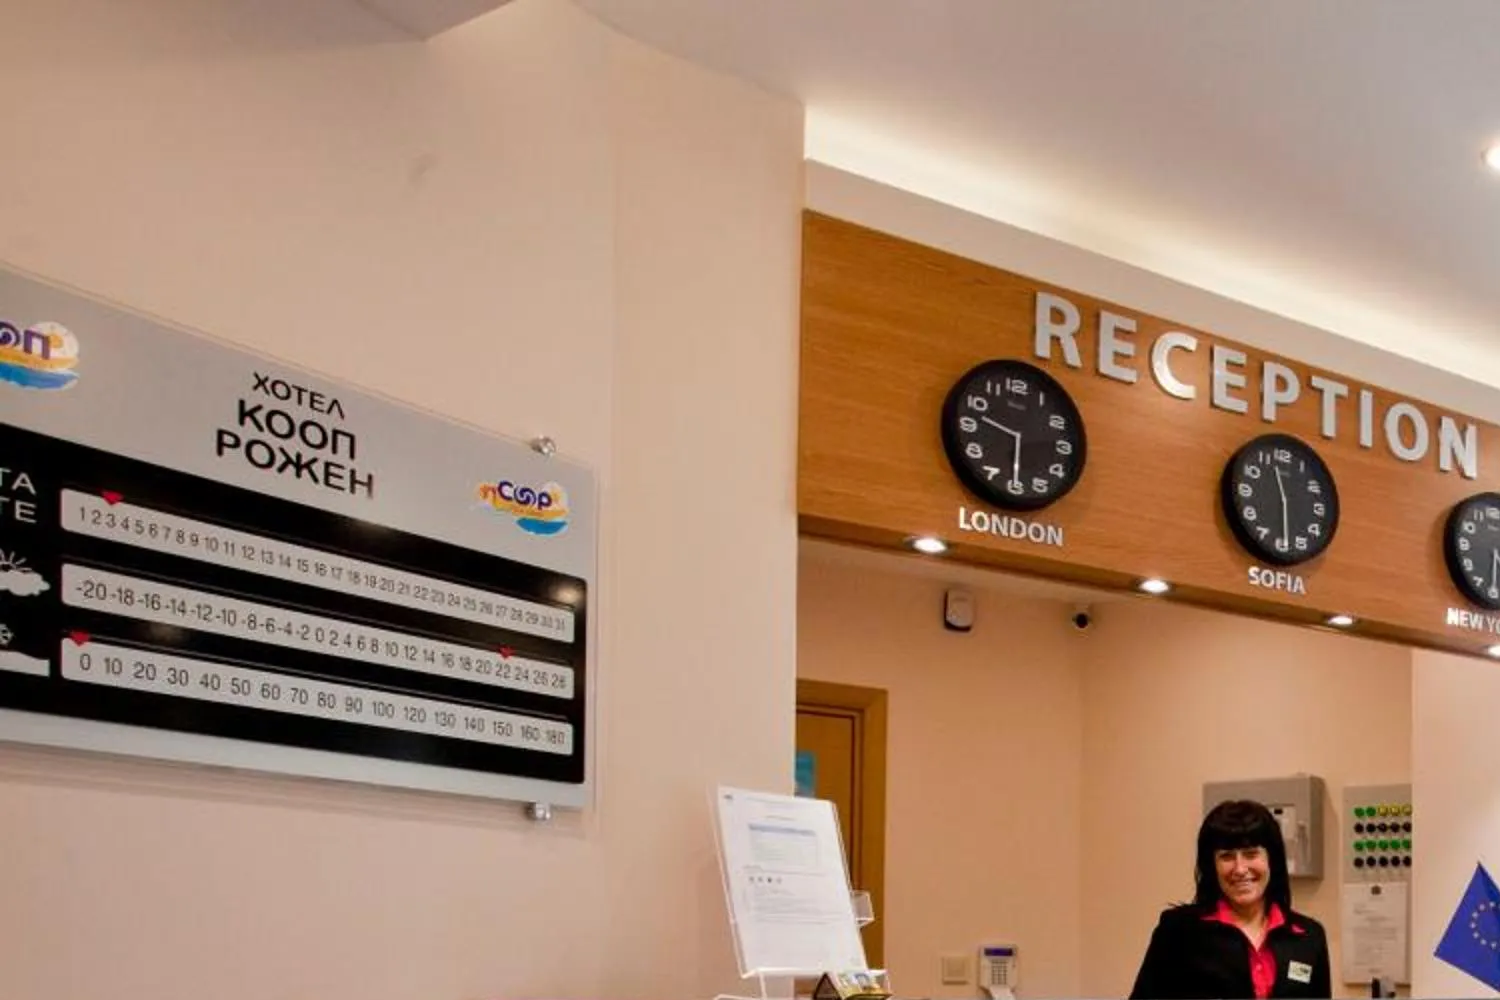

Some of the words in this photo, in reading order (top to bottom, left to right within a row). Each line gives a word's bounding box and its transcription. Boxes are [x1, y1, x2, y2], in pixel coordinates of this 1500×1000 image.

[986, 380, 1001, 396] 11
[1005, 377, 1028, 395] 12
[1034, 291, 1478, 479] RECEPTION
[252, 371, 344, 420] ХОТЕЛ
[967, 395, 988, 411] 10
[1039, 391, 1044, 407] 1
[238, 398, 356, 460] КООП
[959, 416, 977, 433] 9
[1055, 440, 1072, 455] 3
[216, 428, 373, 499] РОЖЕН
[1049, 463, 1065, 478] 4
[1244, 465, 1261, 479] 10
[982, 465, 1000, 481] 7
[959, 506, 1063, 546] LONDON
[1256, 526, 1270, 541] 7
[1307, 523, 1321, 537] 4
[79, 507, 85, 521] 1
[91, 509, 101, 525] 2
[105, 514, 116, 529] 3
[120, 516, 130, 531] 4
[135, 520, 145, 535] 5
[148, 523, 158, 539] 6
[162, 526, 171, 541] 7
[176, 530, 186, 545] 8
[189, 533, 199, 547] 9
[204, 536, 219, 552] 10
[223, 541, 236, 555] 11
[241, 545, 255, 561] 12
[260, 549, 274, 565] 13
[278, 553, 291, 568] 14
[297, 558, 309, 573] 15
[1248, 566, 1307, 595] SOFIA
[1446, 607, 1483, 630] NEW
[76, 580, 107, 601] -20
[111, 586, 135, 606] -18
[137, 593, 161, 611] -16
[165, 599, 187, 616] -14
[189, 603, 213, 621] -12
[215, 608, 237, 626] -10
[315, 627, 325, 643] 0
[329, 630, 339, 647] 2
[343, 633, 352, 649] 4
[357, 636, 367, 651] 6
[370, 639, 380, 654] 8
[384, 641, 399, 658] 10
[403, 645, 417, 661] 12
[423, 649, 435, 664] 14
[475, 658, 491, 675] 20
[495, 662, 511, 679] 22
[79, 653, 91, 671] 0
[104, 656, 123, 675] 10
[133, 661, 157, 681] 20
[167, 667, 189, 686] 30
[200, 673, 221, 691] 40
[231, 677, 251, 696] 50
[260, 683, 281, 700] 60
[290, 687, 308, 705] 70
[345, 697, 363, 713] 90
[372, 700, 395, 719] 100
[404, 705, 426, 723] 120
[434, 711, 456, 728] 130
[493, 721, 513, 737] 150
